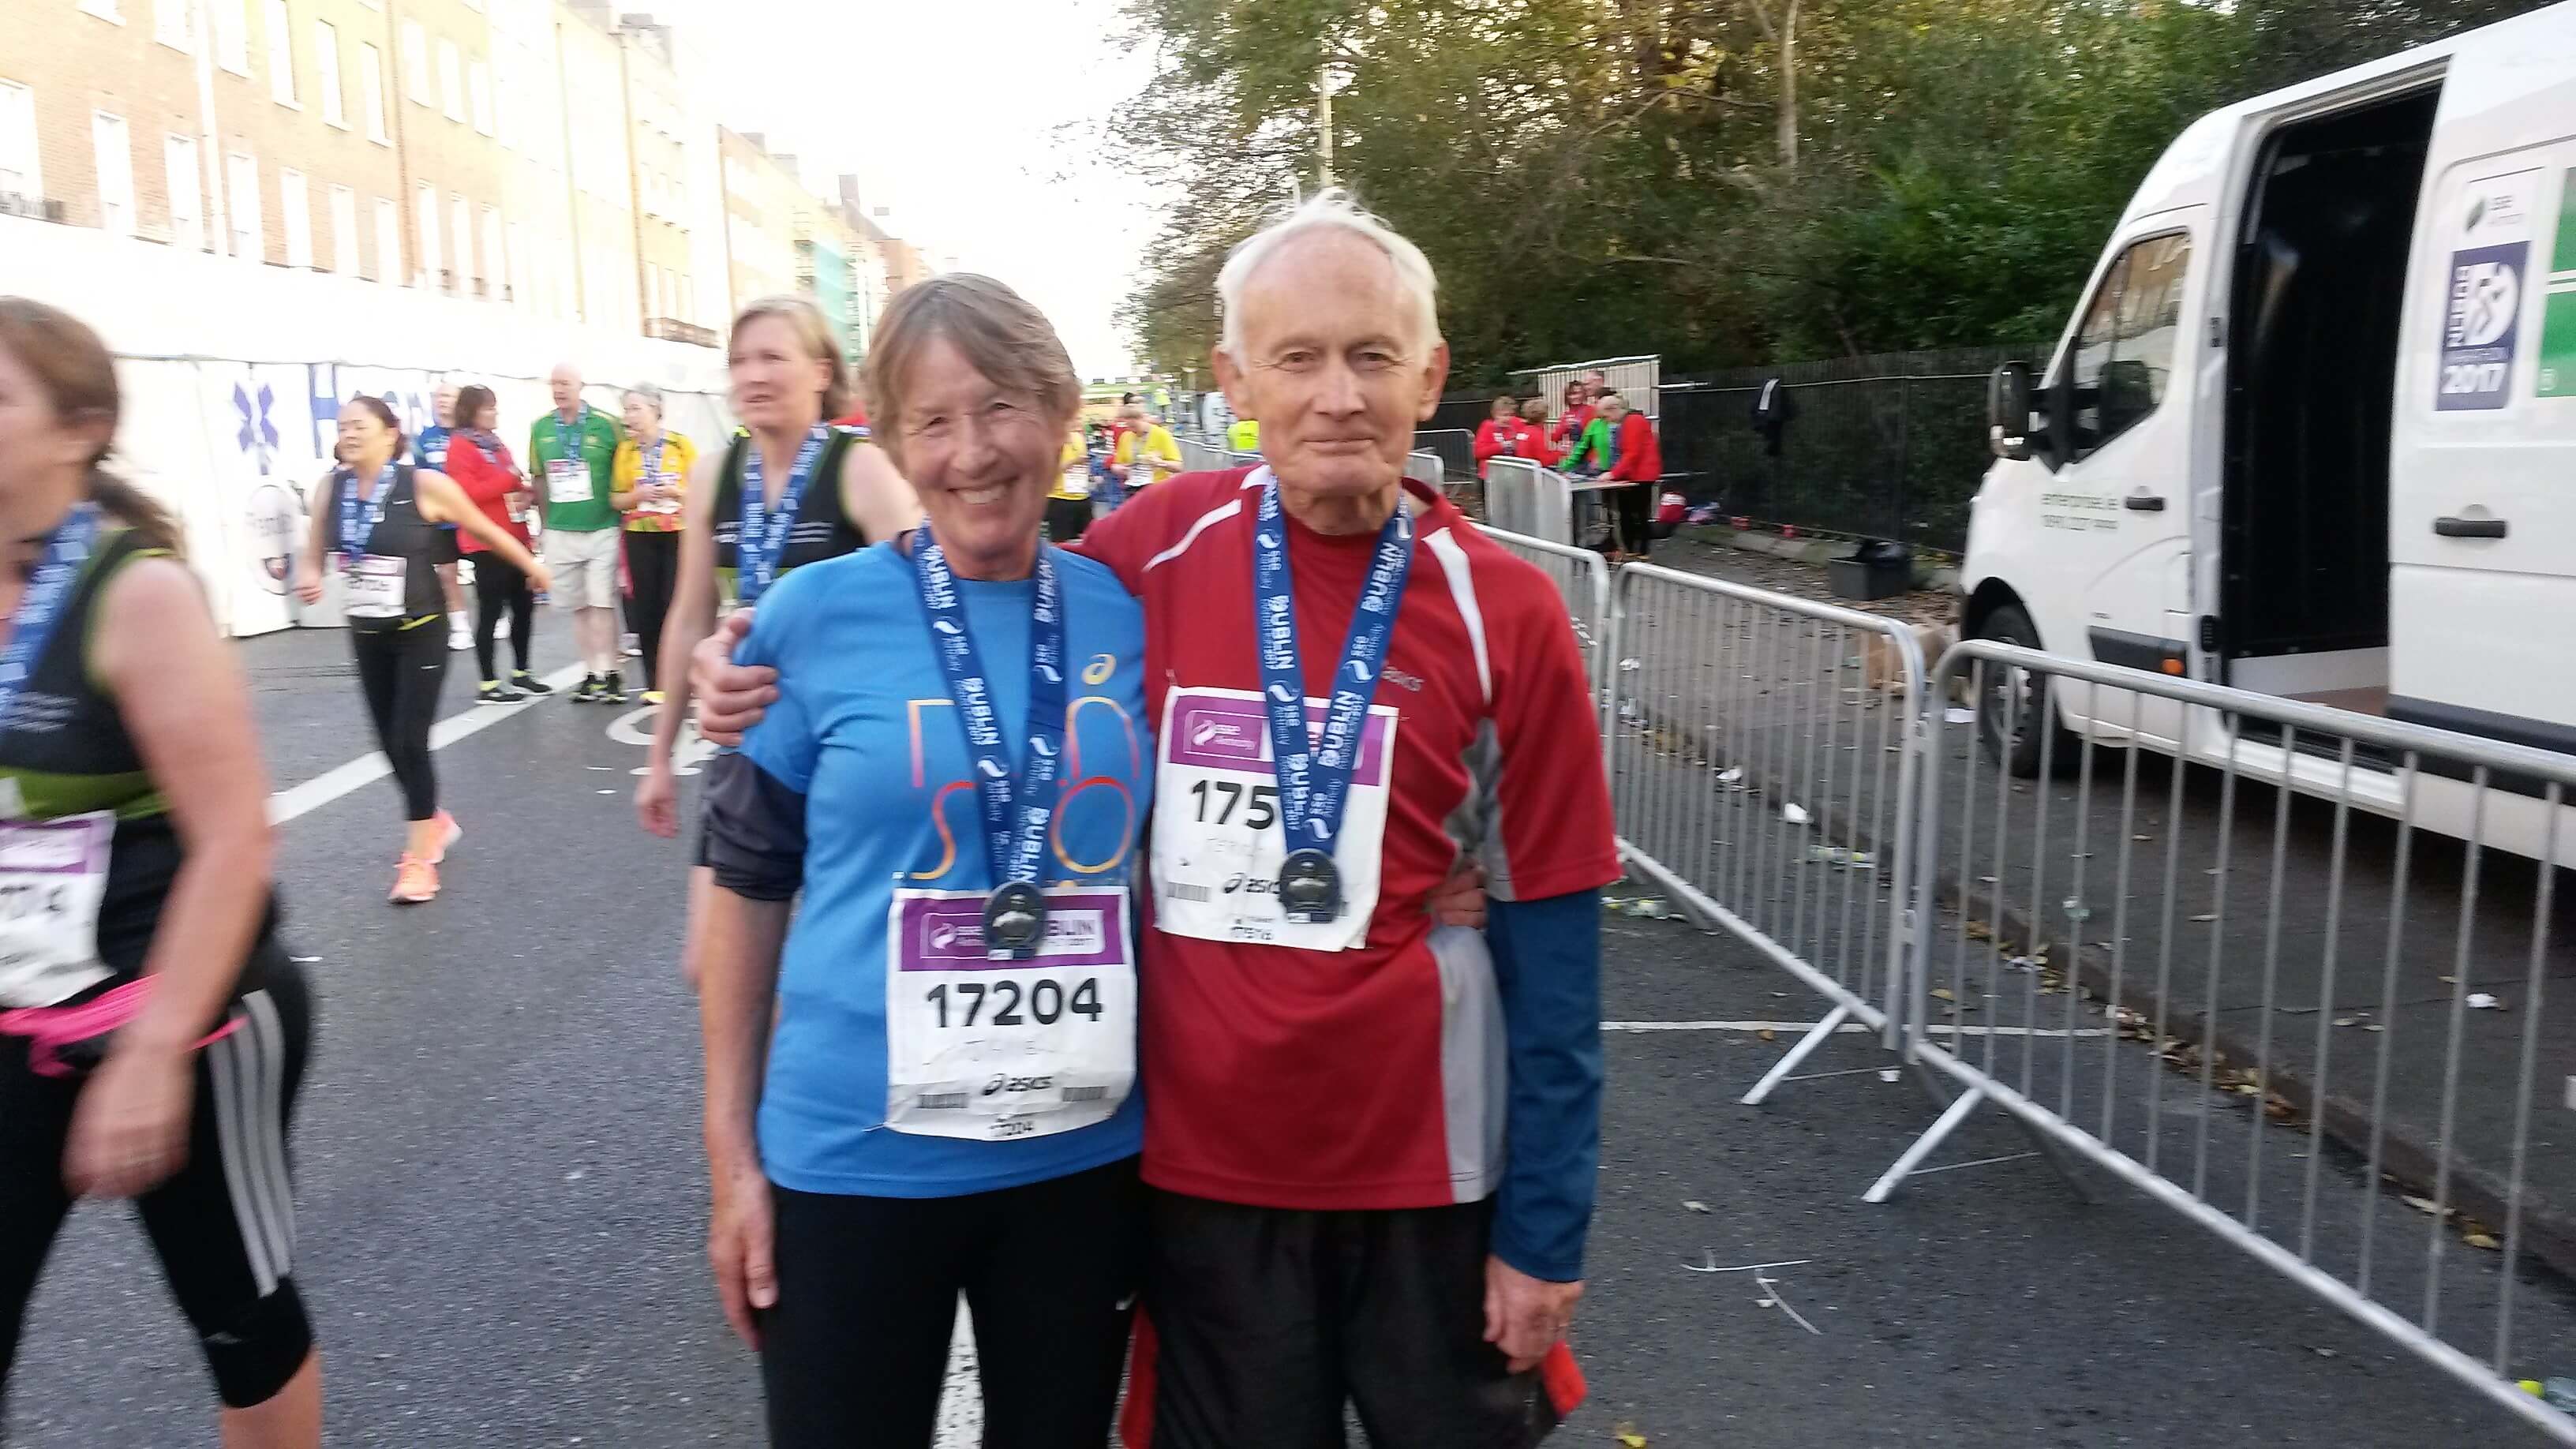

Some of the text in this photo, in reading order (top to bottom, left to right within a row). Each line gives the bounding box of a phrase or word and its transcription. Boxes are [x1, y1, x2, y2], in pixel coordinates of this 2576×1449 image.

[2441, 364, 2507, 394] 2017
[923, 545, 957, 608] DUBLIN
[1361, 542, 1401, 612] DUBLIN
[1268, 595, 1295, 669] DUBLIN
[960, 677, 1001, 744] DUBLIN
[1317, 691, 1356, 766] DUBLIN
[1190, 780, 1279, 829] 175
[1020, 808, 1050, 883] DUBLIN
[927, 978, 1103, 1028] 17204
